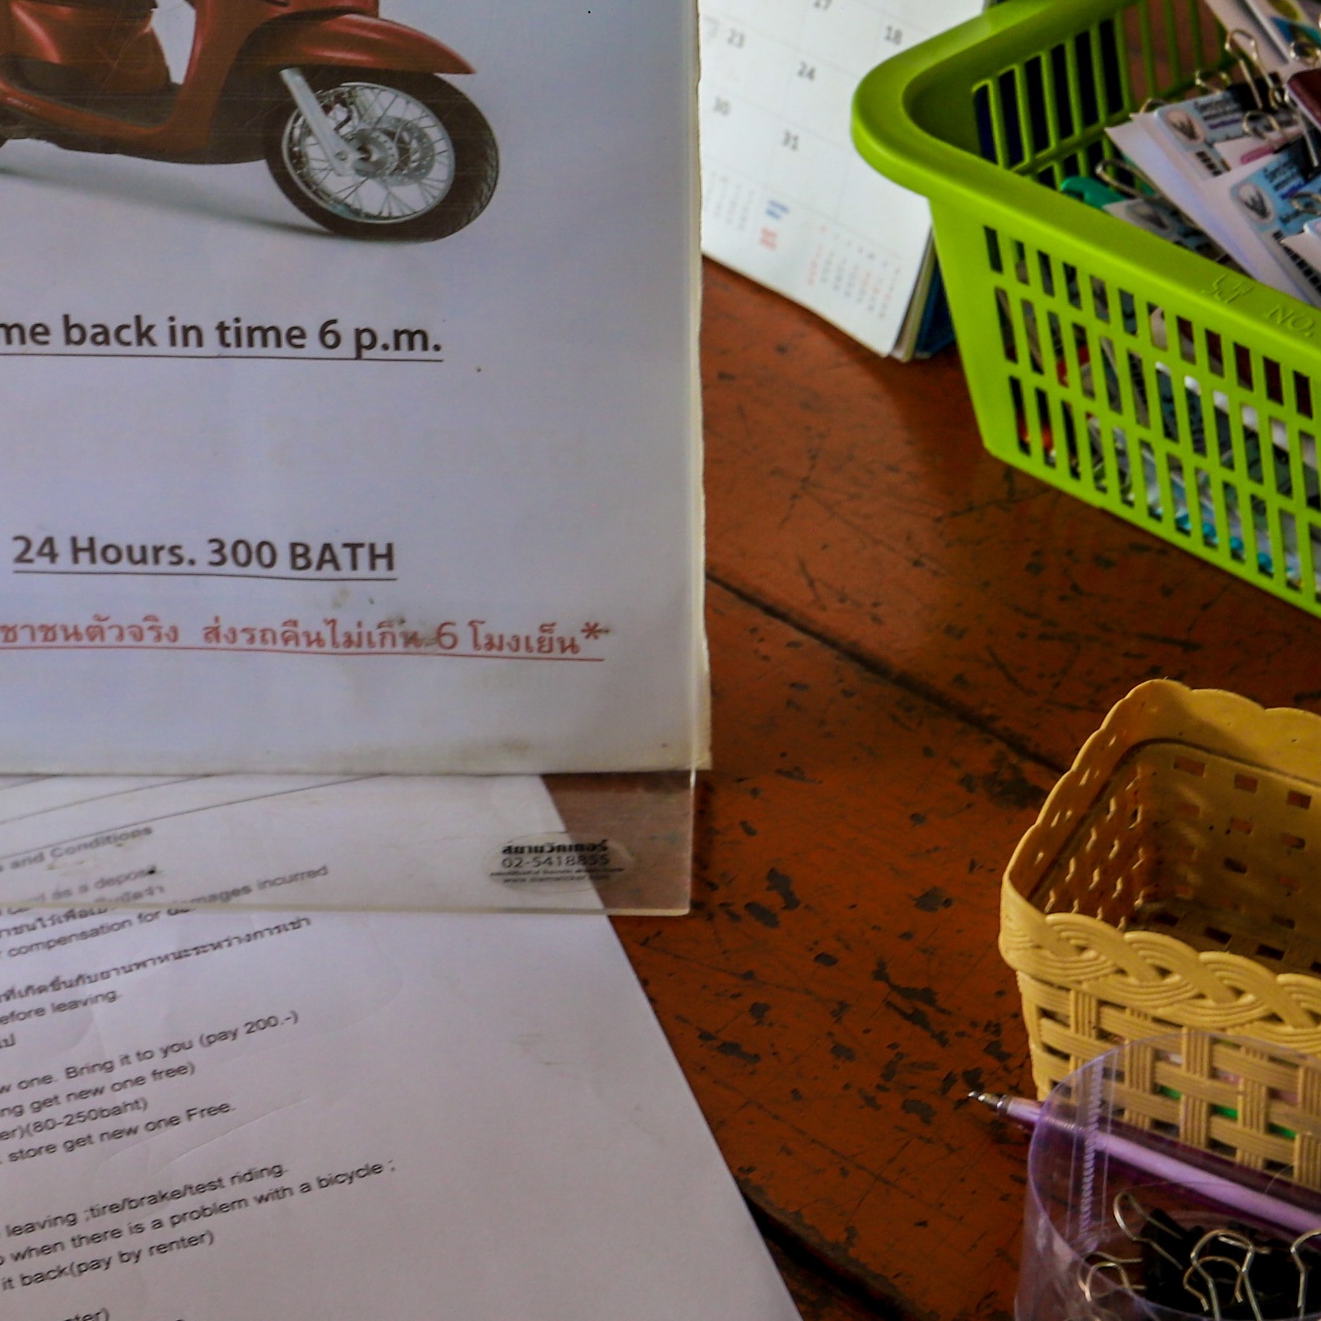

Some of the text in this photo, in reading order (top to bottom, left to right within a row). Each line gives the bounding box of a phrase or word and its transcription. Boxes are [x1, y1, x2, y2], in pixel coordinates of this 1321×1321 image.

[726, 28, 817, 81] 23 24
[884, 25, 904, 46] 18
[781, 129, 800, 151] 31
[62, 315, 157, 348] back
[168, 316, 204, 348] in
[216, 317, 307, 350] time
[318, 319, 342, 349] 6
[354, 324, 442, 360] p.m.
[12, 535, 395, 572] 24 Hours. 300 BATH
[10, 850, 45, 869] and
[50, 824, 153, 859] Conditions
[7, 920, 132, 957] compensation
[137, 904, 161, 924] for
[257, 865, 329, 890] incurred
[65, 1060, 114, 1079] Bring
[120, 1054, 131, 1066] it
[135, 1050, 154, 1062] to
[160, 1040, 193, 1058] you
[199, 1028, 238, 1047] (pay
[30, 1095, 61, 1113] get
[66, 1086, 105, 1101] new
[110, 1076, 146, 1092] one
[151, 1062, 195, 1081] free)
[8, 1144, 57, 1162] store
[63, 1134, 94, 1152] get
[99, 1126, 138, 1142] new
[144, 1116, 181, 1132] one
[6, 1213, 78, 1237] leaving
[10, 1242, 65, 1262] when
[70, 1228, 122, 1248] there
[170, 1198, 248, 1228] problem
[254, 1186, 294, 1204] with
[316, 1164, 383, 1189] bicycle
[2, 1277, 15, 1291] it
[20, 1257, 112, 1286] back(pay
[148, 1230, 214, 1256] renter)
